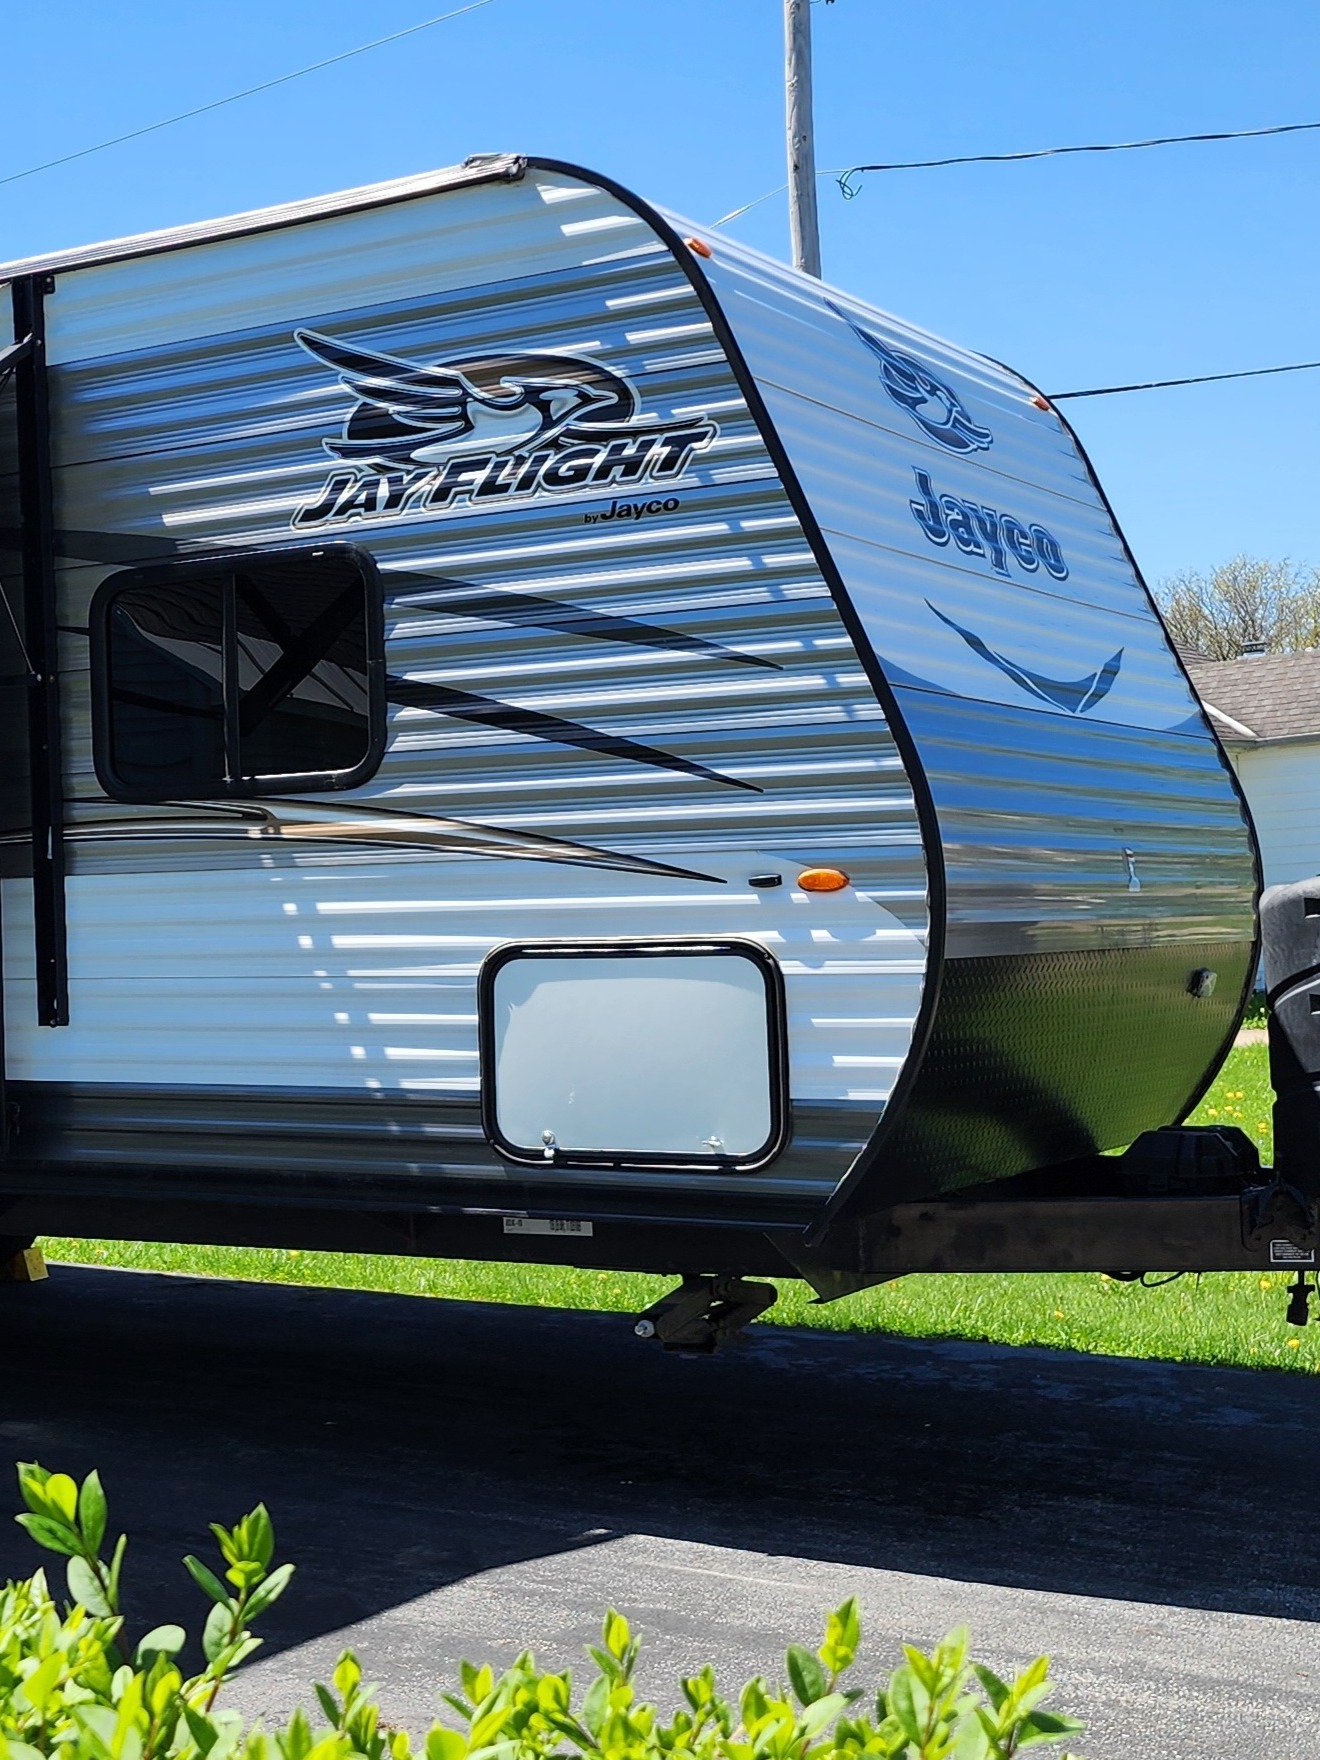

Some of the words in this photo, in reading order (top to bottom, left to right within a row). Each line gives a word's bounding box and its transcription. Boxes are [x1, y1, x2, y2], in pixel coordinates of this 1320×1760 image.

[294, 468, 433, 528] JAY
[427, 427, 718, 508] FLIGHT
[584, 511, 599, 524] by
[600, 497, 680, 522] Jayco
[909, 465, 1069, 581] Jayco
